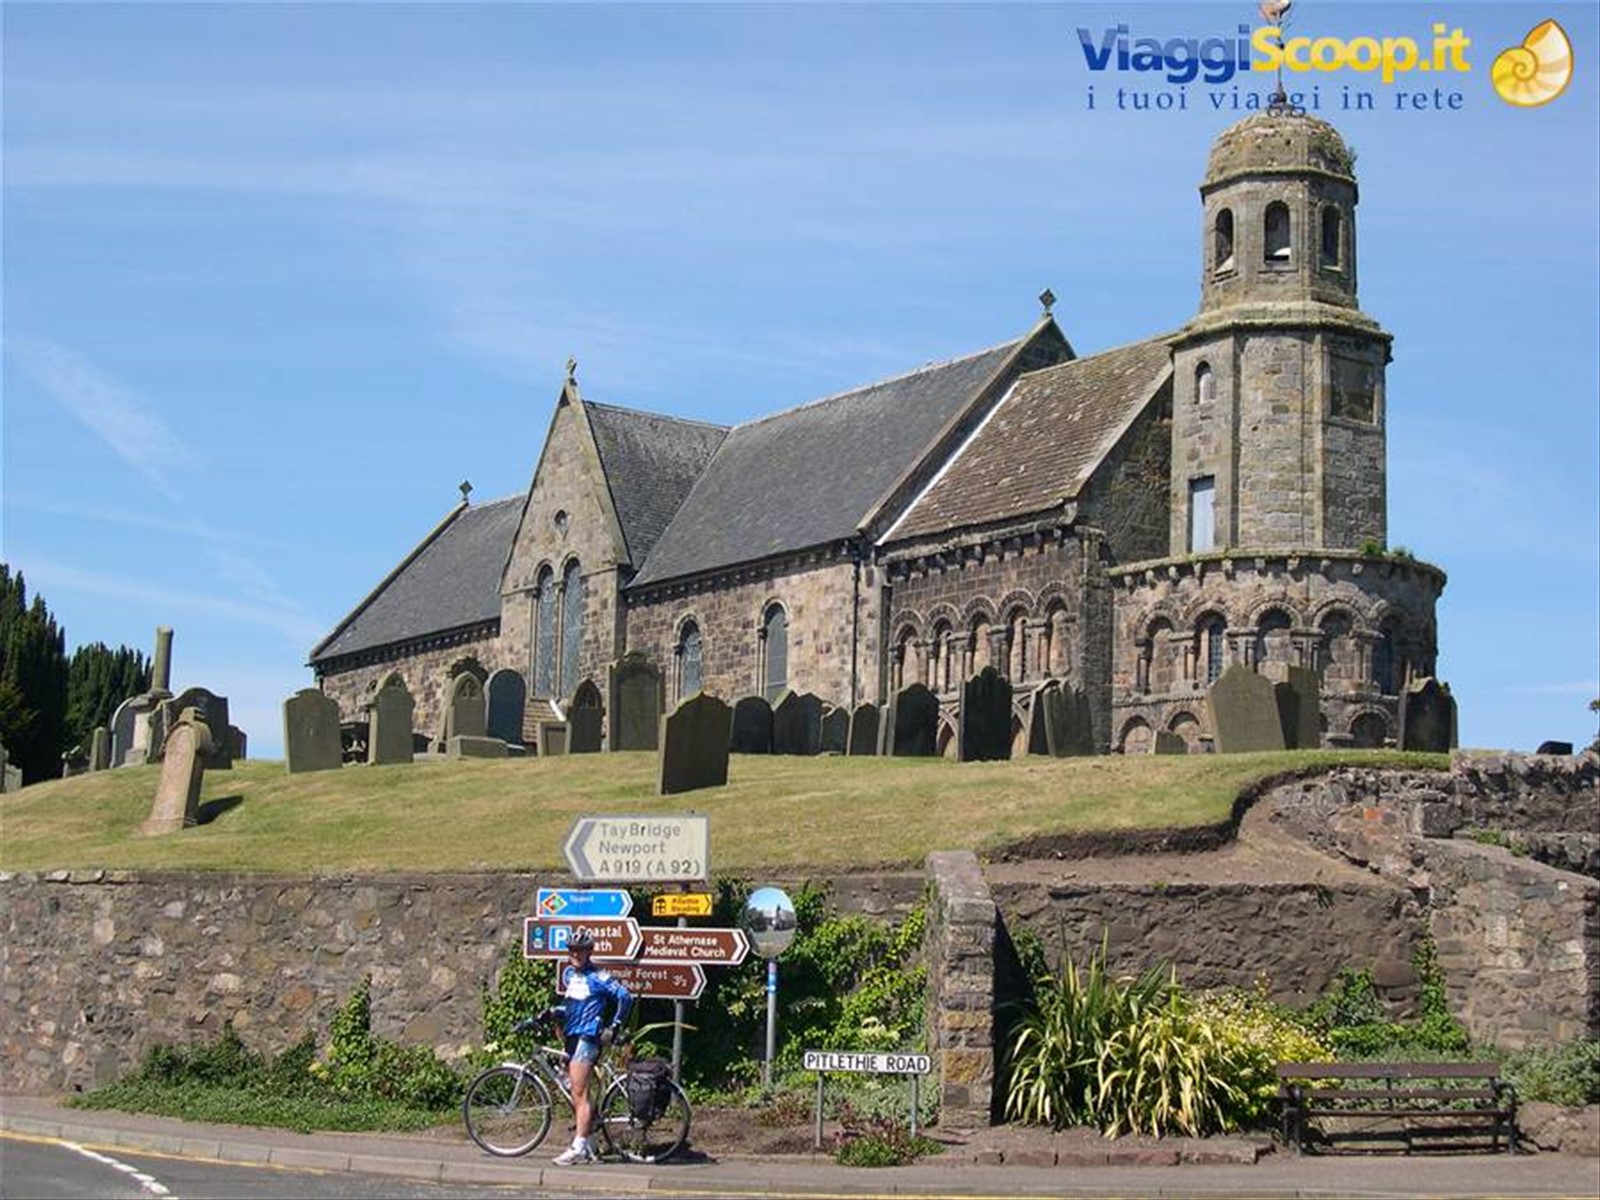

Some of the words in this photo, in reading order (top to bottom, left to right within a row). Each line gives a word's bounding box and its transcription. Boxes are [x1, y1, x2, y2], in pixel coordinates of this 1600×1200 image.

[599, 841, 666, 857] Newport
[593, 939, 613, 951] ath
[653, 935, 667, 945] St
[669, 935, 718, 946] Athernase
[644, 946, 687, 957] Medieval
[691, 947, 726, 958] Church
[635, 968, 668, 980] Forest
[806, 1054, 878, 1070] PITLETHIE
[886, 1056, 928, 1072] ROAD
